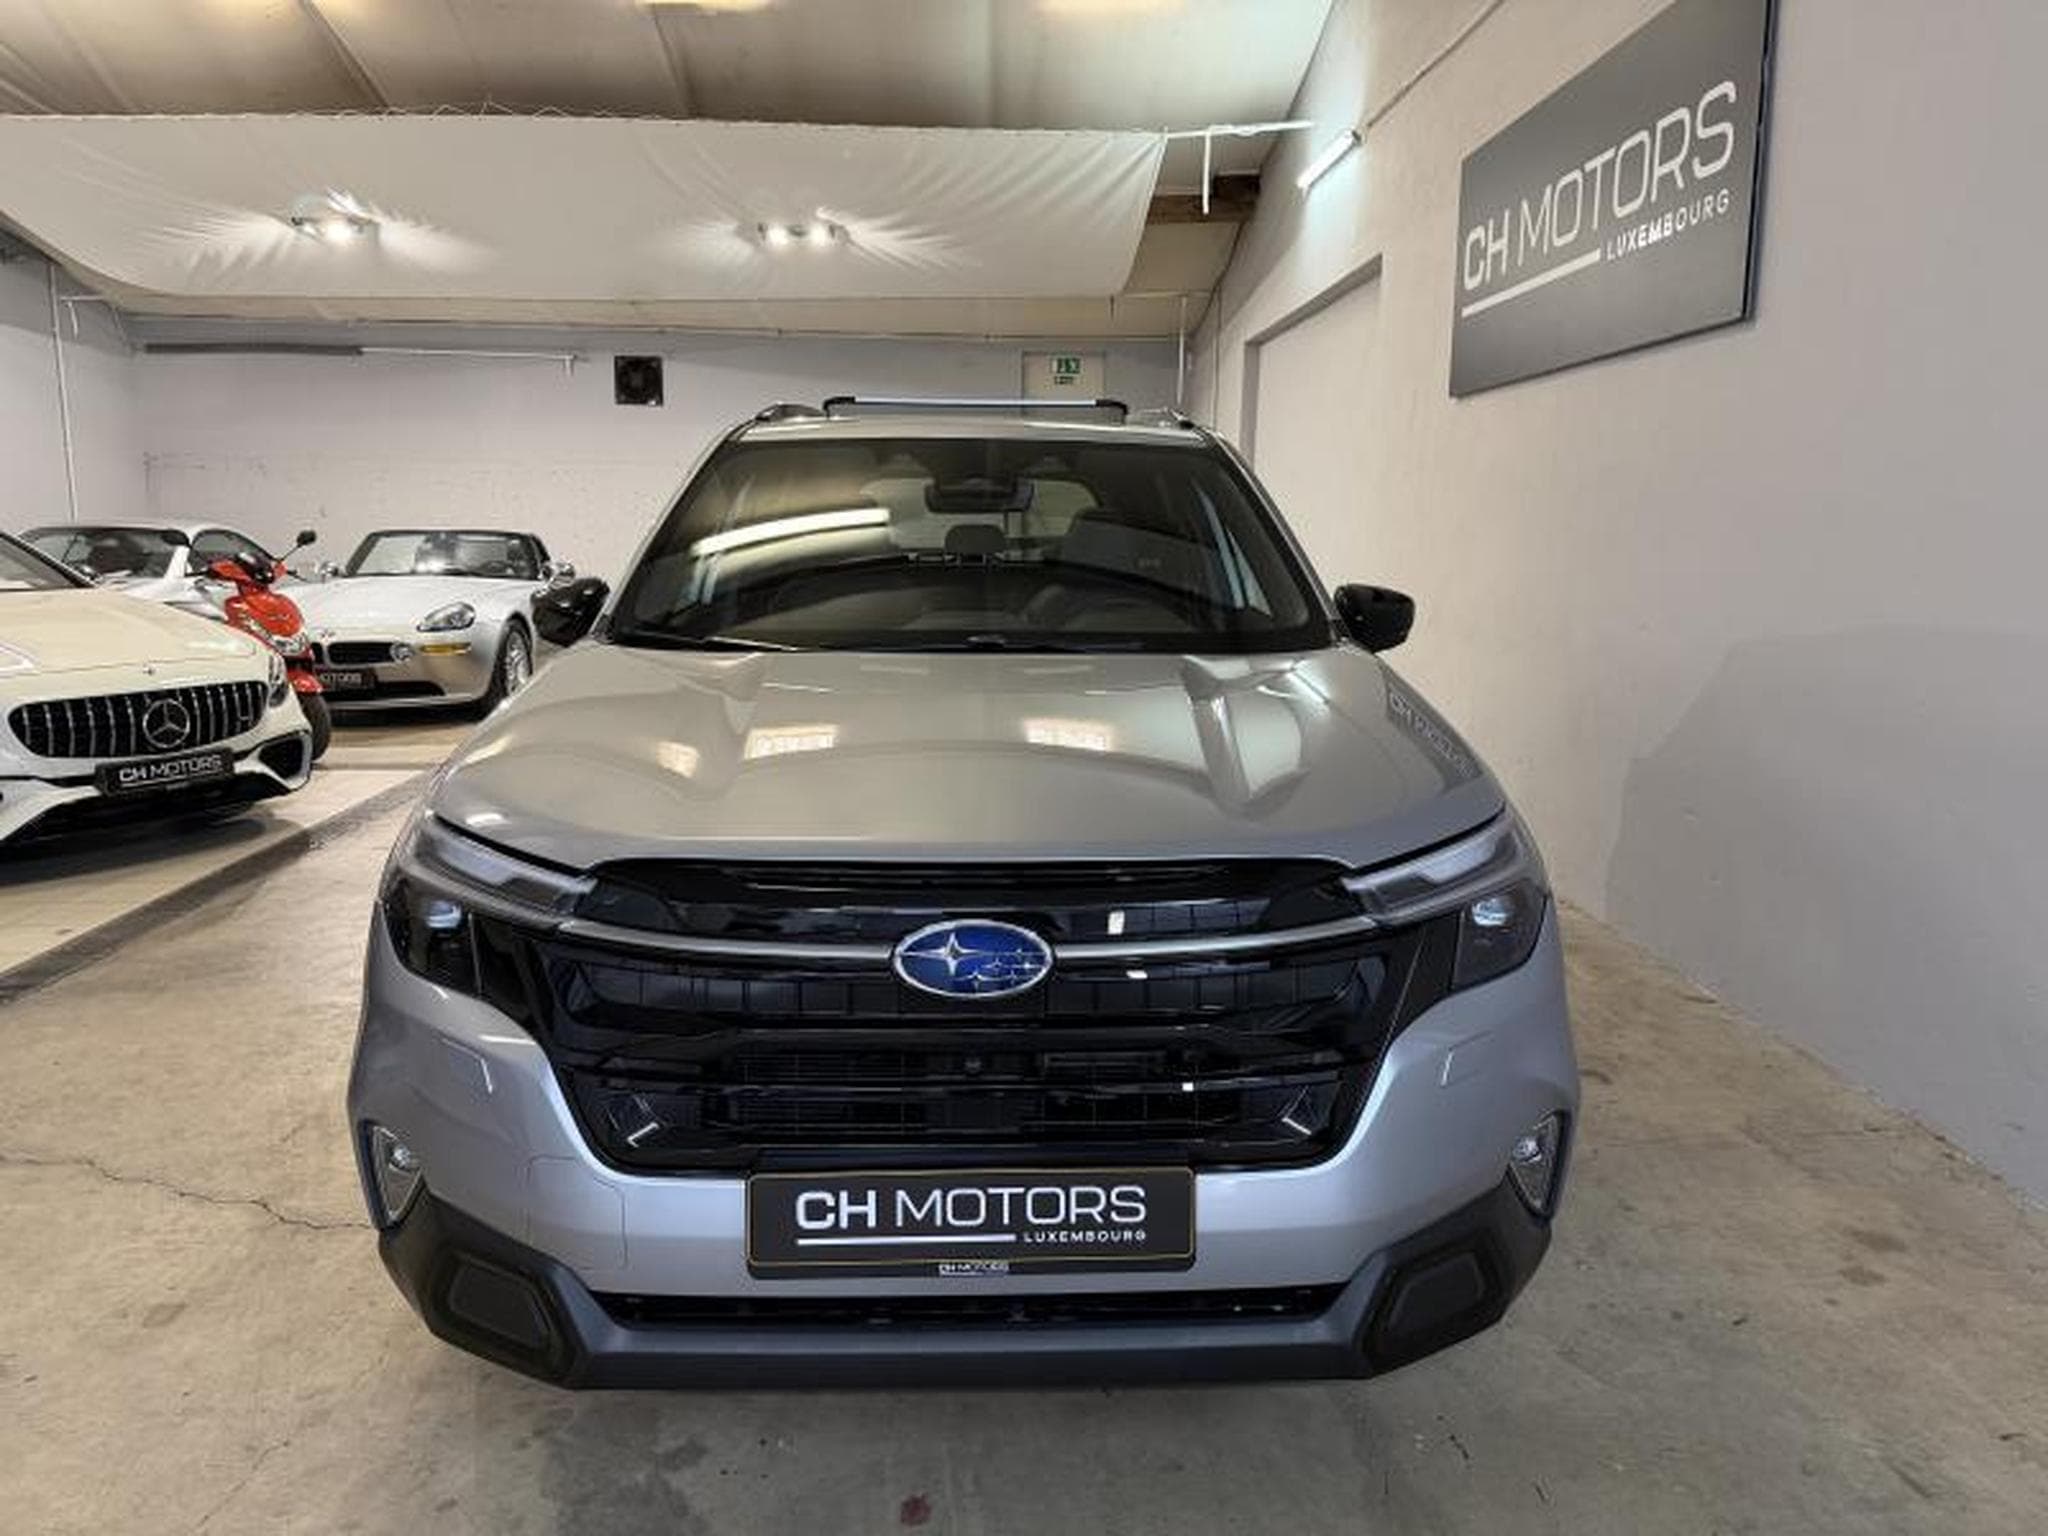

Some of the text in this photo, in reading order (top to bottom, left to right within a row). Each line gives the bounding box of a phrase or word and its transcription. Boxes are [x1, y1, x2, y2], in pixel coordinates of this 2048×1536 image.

[1463, 80, 1736, 291] CH MOTORS
[1606, 188, 1730, 261] LUXEMBOURG
[119, 766, 147, 781] CH
[150, 754, 222, 777] MOTORS
[796, 1185, 1146, 1230] CH MOTORS
[1024, 1230, 1146, 1242] LUXEMBOURG
